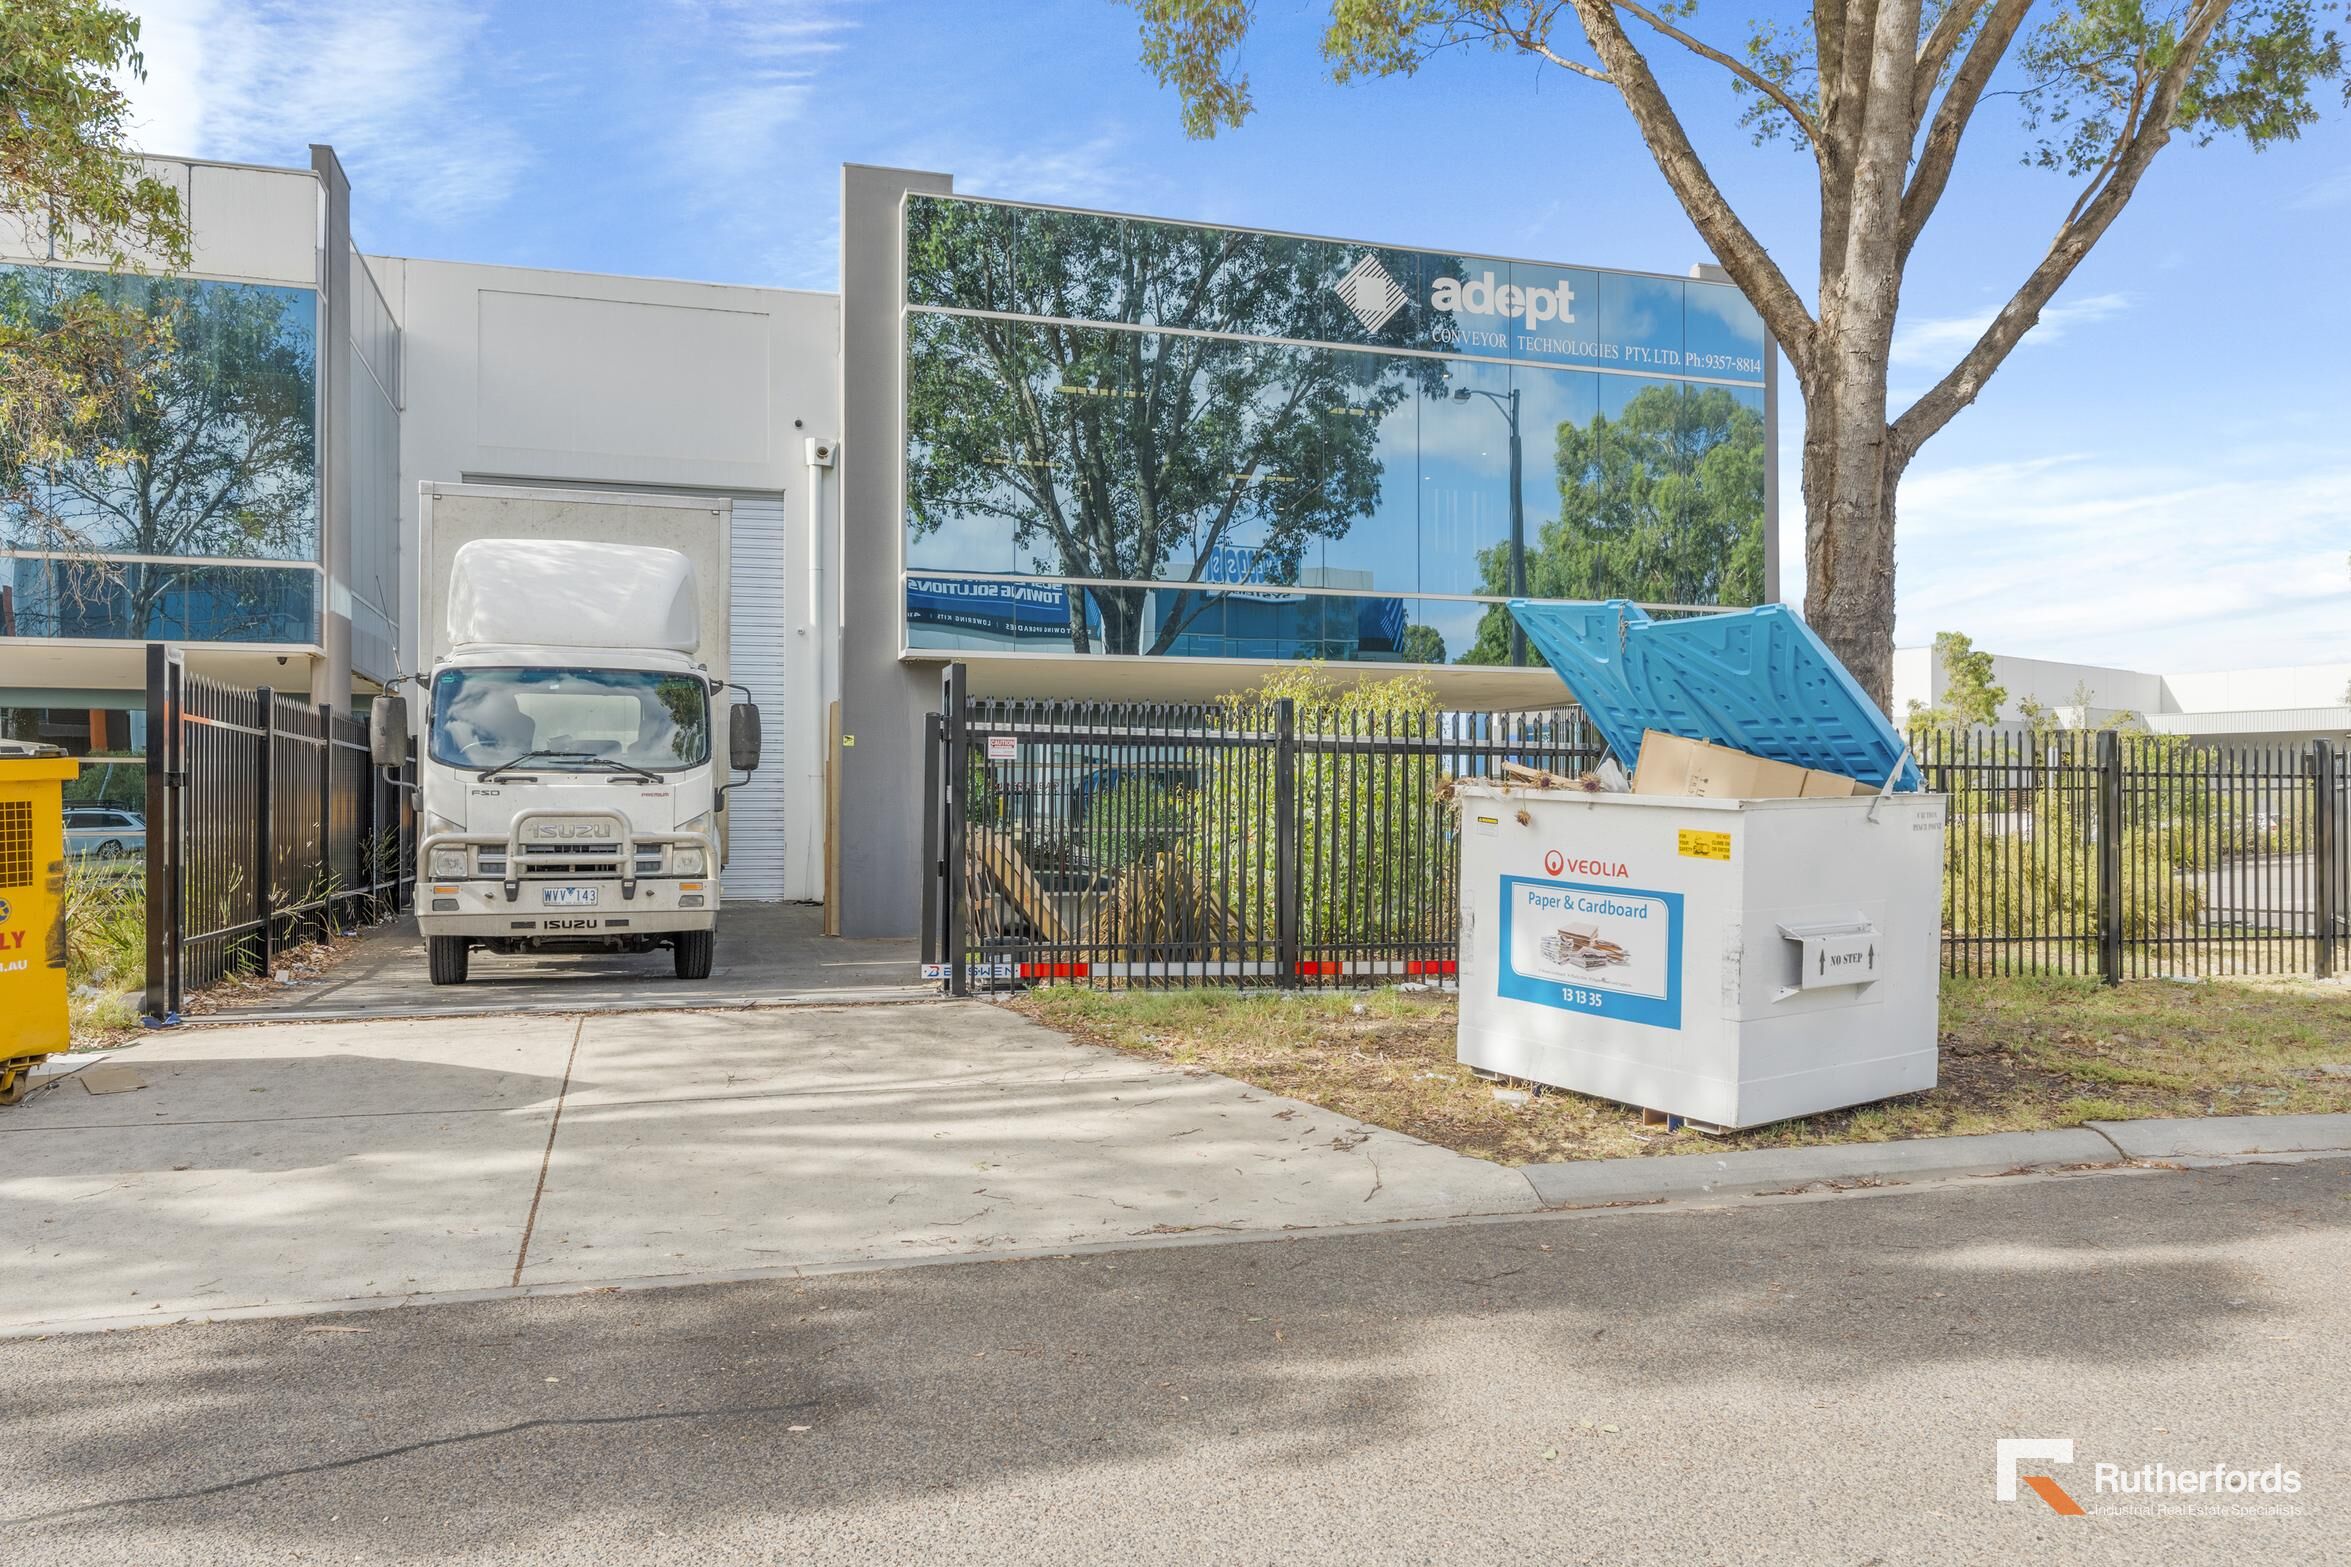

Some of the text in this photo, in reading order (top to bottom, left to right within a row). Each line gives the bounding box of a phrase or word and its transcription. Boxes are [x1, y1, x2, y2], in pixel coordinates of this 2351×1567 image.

[1431, 271, 1575, 331] adept
[1432, 328, 1507, 348] CONVEYOR
[1517, 336, 1619, 359] TECHNOLOGIES
[532, 823, 611, 839] ISUZU
[1567, 858, 1629, 878] VEOLIA
[576, 889, 596, 902] 143
[1528, 891, 1648, 919] Paper & Cardboard
[544, 919, 598, 930] ISUZU
[1830, 952, 1863, 967] NO STEP
[1562, 987, 1602, 1007] 13 13 35
